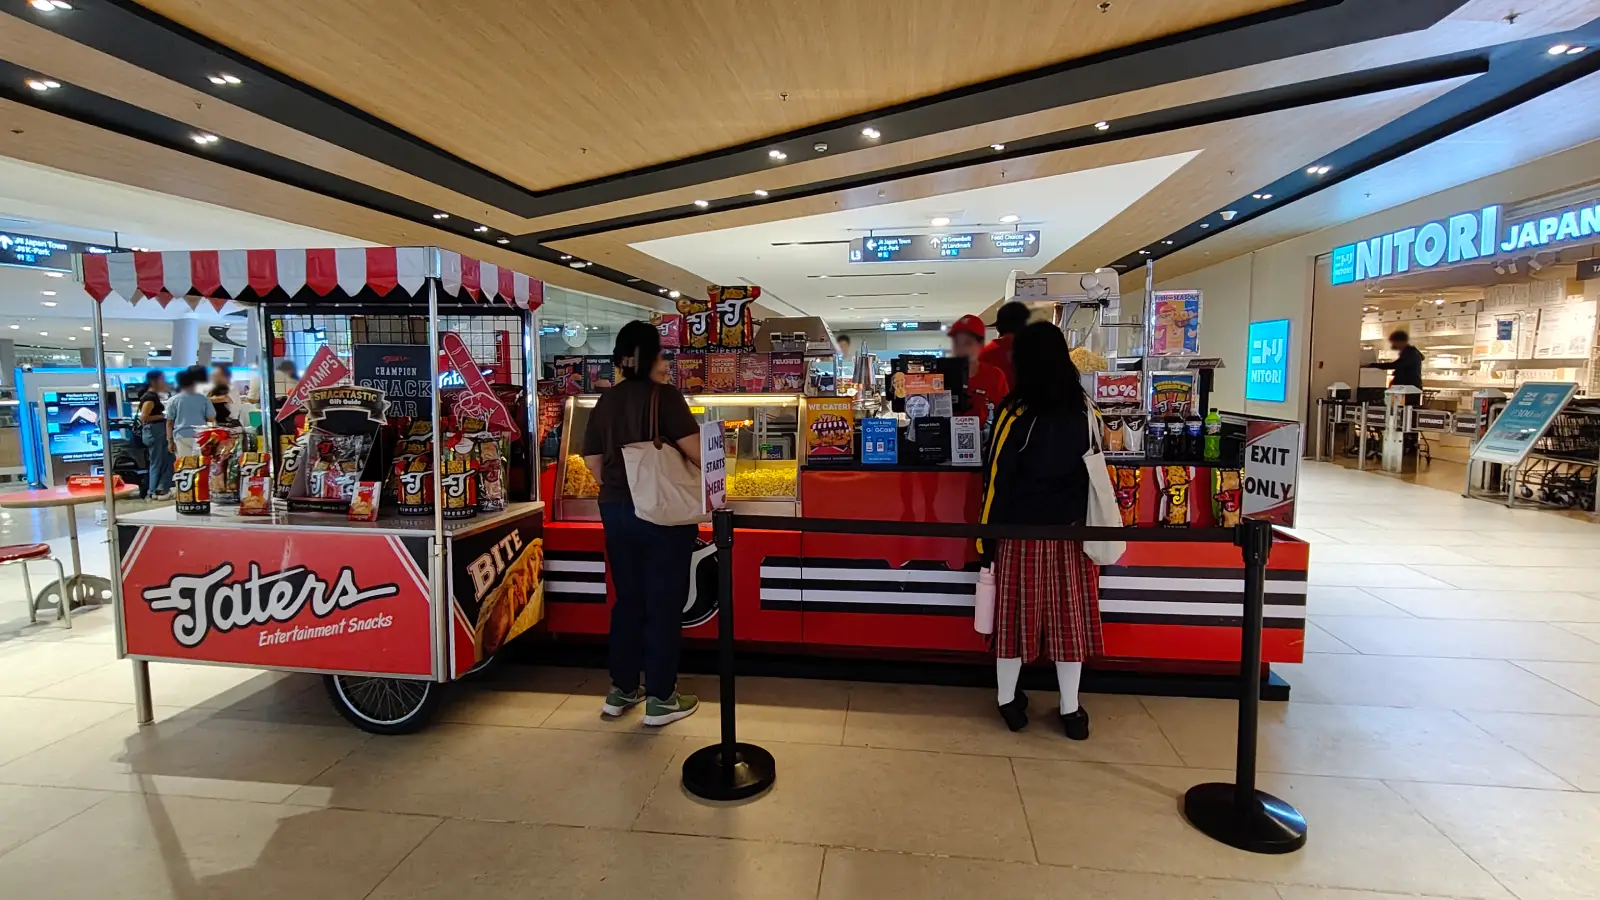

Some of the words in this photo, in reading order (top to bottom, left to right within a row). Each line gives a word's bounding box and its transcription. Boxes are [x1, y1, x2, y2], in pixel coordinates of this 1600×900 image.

[25, 238, 47, 247] Japan
[47, 241, 68, 250] Town
[1356, 205, 1498, 280] NITORI
[1500, 204, 1600, 252] JAPAN
[851, 250, 861, 260] L3
[1252, 339, 1283, 364] ニトリ
[300, 355, 338, 396] CHAMPS
[375, 367, 417, 376] CHAMPION
[1252, 370, 1282, 384] NITORI
[1099, 384, 1136, 397] 10%
[386, 401, 418, 417] AR
[708, 435, 723, 451] LINE
[1251, 446, 1290, 466] EXIT
[706, 458, 725, 473] STARTS
[708, 478, 724, 495] HERE
[1245, 476, 1292, 501] ONLY
[467, 528, 522, 602] BITE
[143, 562, 397, 646] Taters
[259, 620, 346, 646] Entertainment
[348, 614, 394, 634] Snacks
